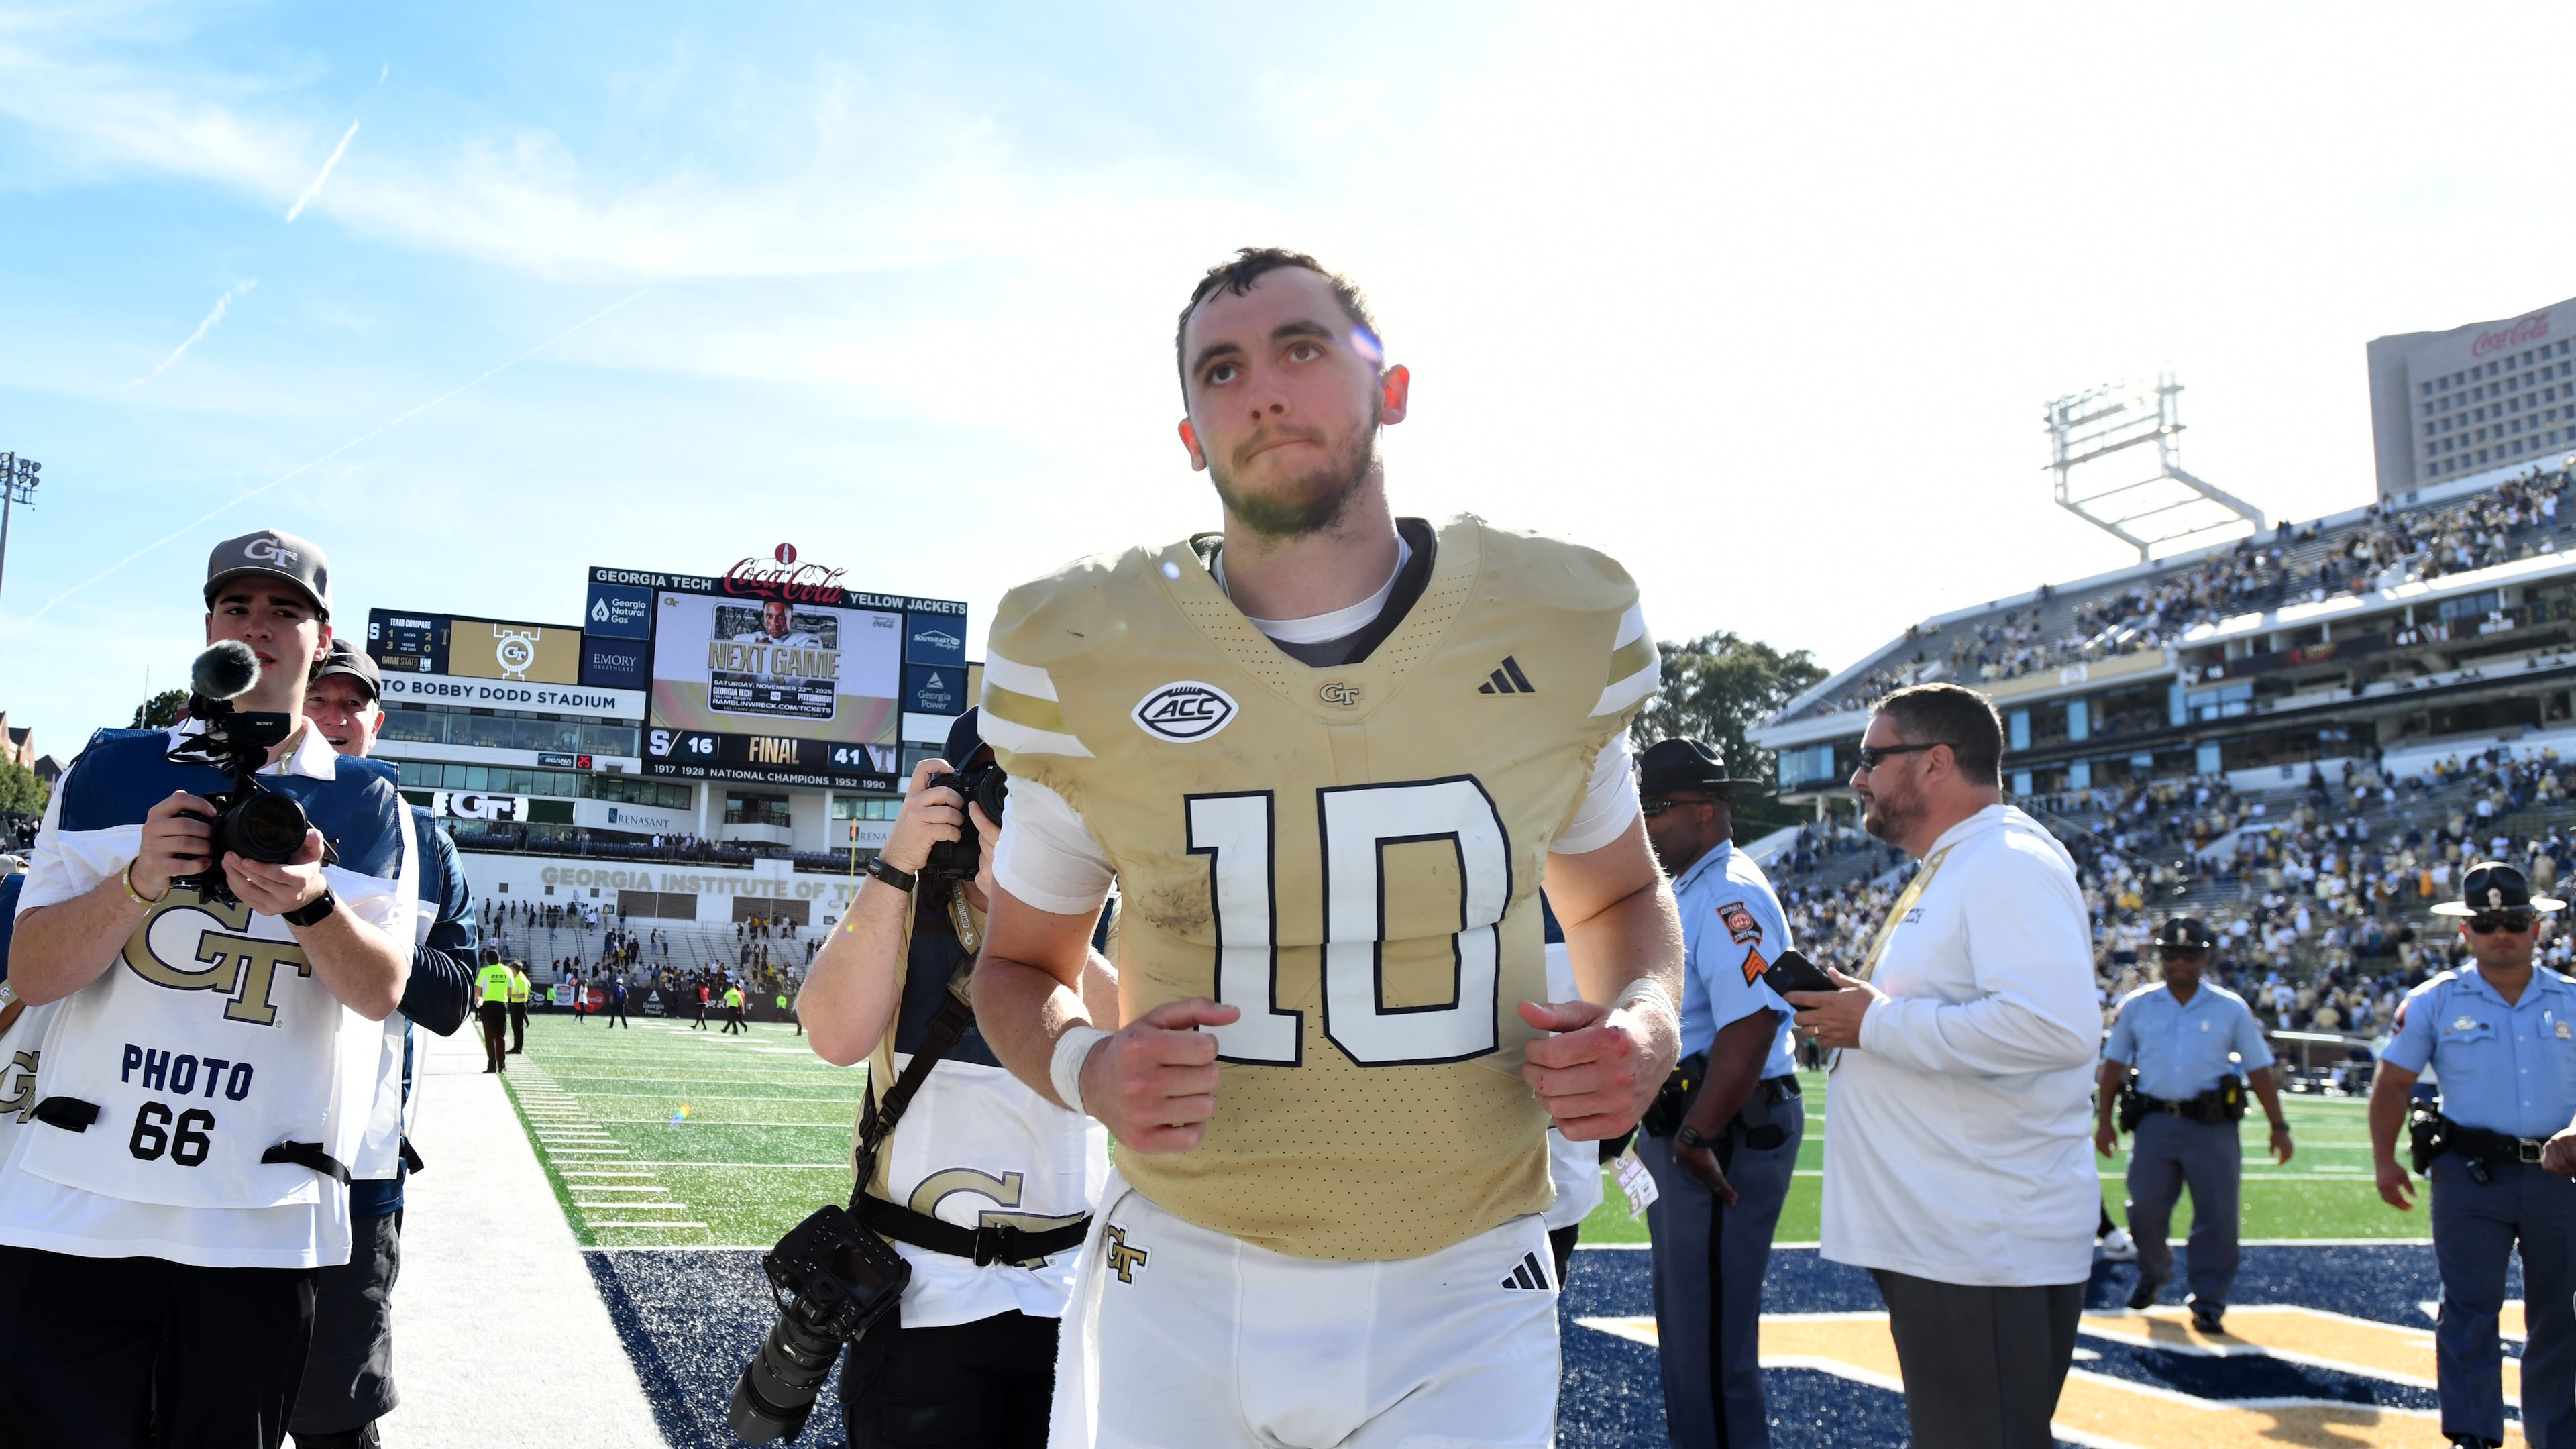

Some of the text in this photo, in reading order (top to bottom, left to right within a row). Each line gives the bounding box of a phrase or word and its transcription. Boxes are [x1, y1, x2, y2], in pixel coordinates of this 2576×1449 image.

[2472, 313, 2550, 357] Coca-Cola
[244, 537, 298, 568] GT
[596, 570, 712, 590] GEORGIA TECH
[724, 558, 849, 603] Coca-Cola
[612, 598, 646, 609] Georgia
[850, 593, 966, 615] YELLOW JACKETS
[610, 615, 628, 623] Gas
[611, 607, 644, 617] Natural
[368, 622, 380, 640] S
[390, 618, 431, 629] TEAM COMPARE
[388, 629, 394, 637] 1
[425, 632, 432, 641] 2
[386, 641, 394, 649] 3
[423, 645, 431, 653] 0
[382, 655, 400, 665] GAME
[400, 657, 418, 666] STATS
[593, 653, 637, 666] EMORY
[708, 641, 841, 679] NEXT GAME
[593, 664, 634, 672] HEALTHCARE
[713, 687, 752, 698] GEORGIA TECH
[714, 680, 755, 689] SATURDAY,
[756, 684, 796, 692] NOVEMBER
[1319, 682, 1360, 706] GT
[382, 679, 615, 710] TO BOBBY DODD STADIUM
[797, 693, 833, 703] PITTSBURGH
[918, 690, 951, 702] Georgia
[712, 699, 831, 713] RAMBLINWRECK.COM/TICKETS
[921, 700, 947, 710] Power
[1152, 697, 1215, 719] ACC
[649, 729, 670, 757] S
[688, 737, 713, 754] 16
[749, 736, 800, 765] FINAL
[578, 756, 591, 768] 25
[835, 748, 859, 765] 41
[654, 764, 886, 790] 1917 1928 NATIONAL CHAMPIONS 1952 1990
[619, 814, 669, 829] RENASANT
[860, 831, 887, 841] RENA
[541, 865, 653, 890] GEORGIA
[661, 873, 788, 897] INSTITUTE
[794, 881, 826, 900] OF
[953, 879, 961, 897] TEC
[956, 898, 970, 928] GEORGIA
[1720, 903, 1743, 915] GEORGIA
[1183, 773, 1513, 1067] 10
[121, 1043, 254, 1102] PHOTO
[129, 1100, 215, 1167] 66
